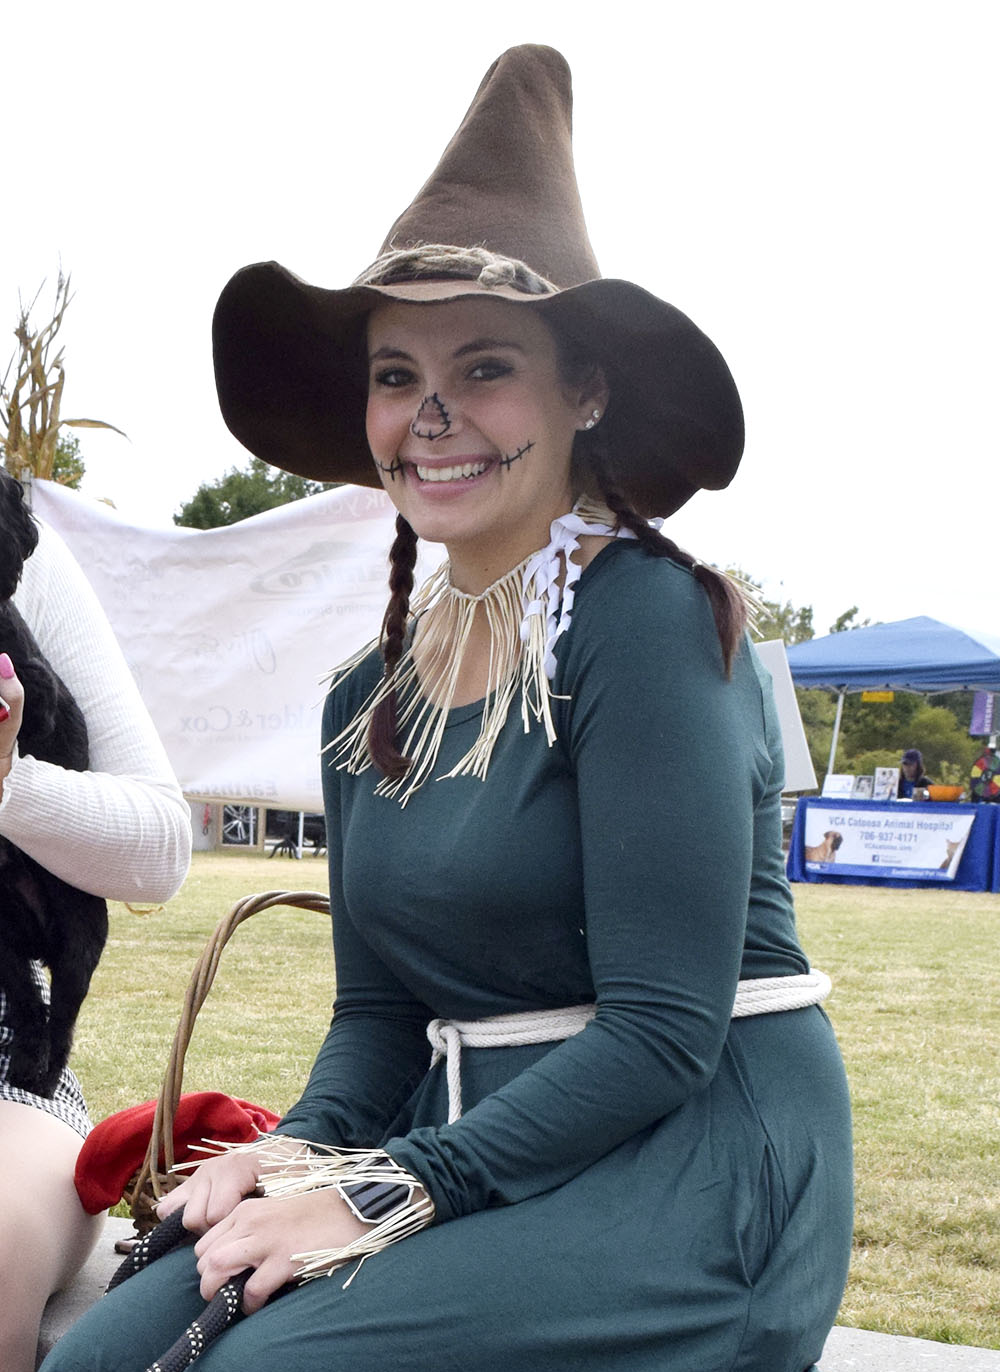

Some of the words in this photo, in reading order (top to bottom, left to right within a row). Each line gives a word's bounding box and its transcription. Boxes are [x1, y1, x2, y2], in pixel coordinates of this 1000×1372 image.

[829, 816, 846, 826] VCA
[884, 819, 914, 829] Animal
[917, 820, 954, 832] Hospital
